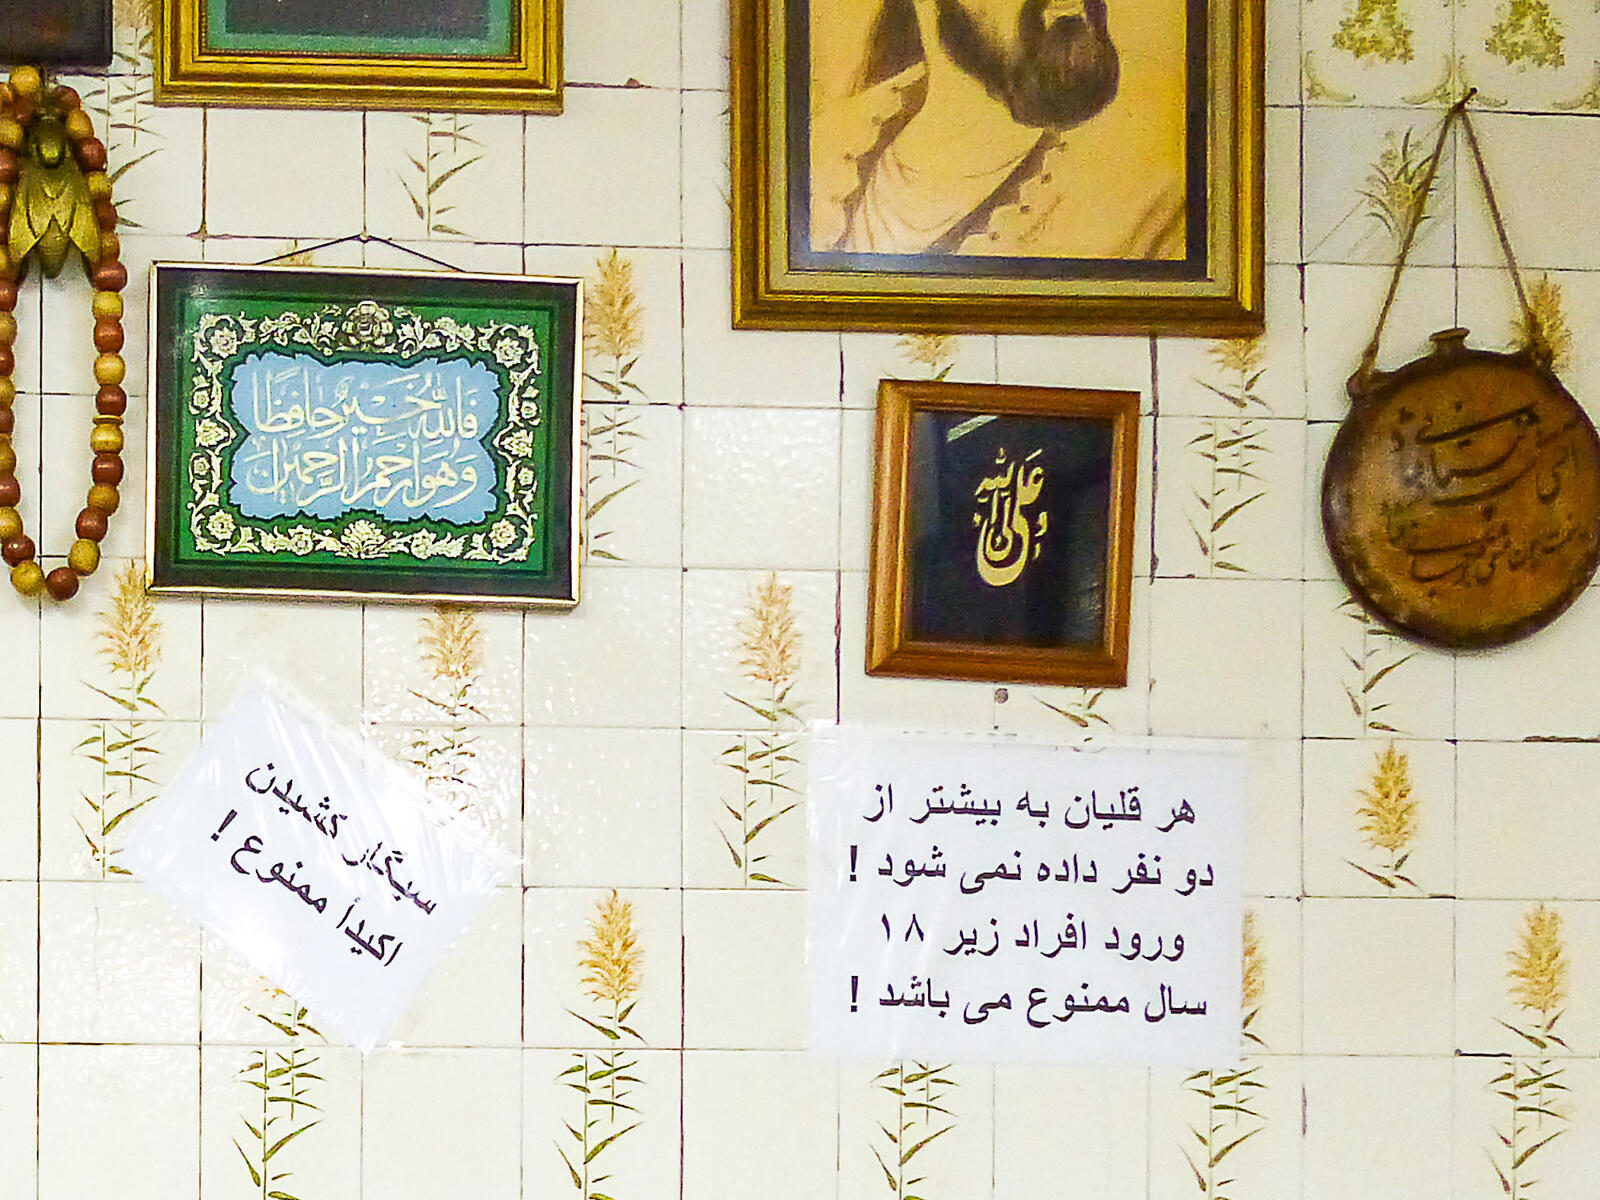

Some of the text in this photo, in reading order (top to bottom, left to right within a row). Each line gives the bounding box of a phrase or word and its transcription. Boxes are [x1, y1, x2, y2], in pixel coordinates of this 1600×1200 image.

[862, 783, 1196, 833] هر قلیان به بیشتر از
[230, 835, 328, 914] ممنوع
[878, 845, 946, 888] شود
[959, 850, 1022, 895] نمی
[1037, 853, 1098, 884] داده
[1111, 852, 1162, 895] نفر
[1174, 863, 1214, 897] دو
[881, 912, 1185, 962] ورود افراد زیر ۱۸
[879, 975, 950, 1019] باشد
[963, 992, 1012, 1025] می
[1026, 982, 1130, 1029] ممنوع
[1144, 983, 1207, 1023] سال
